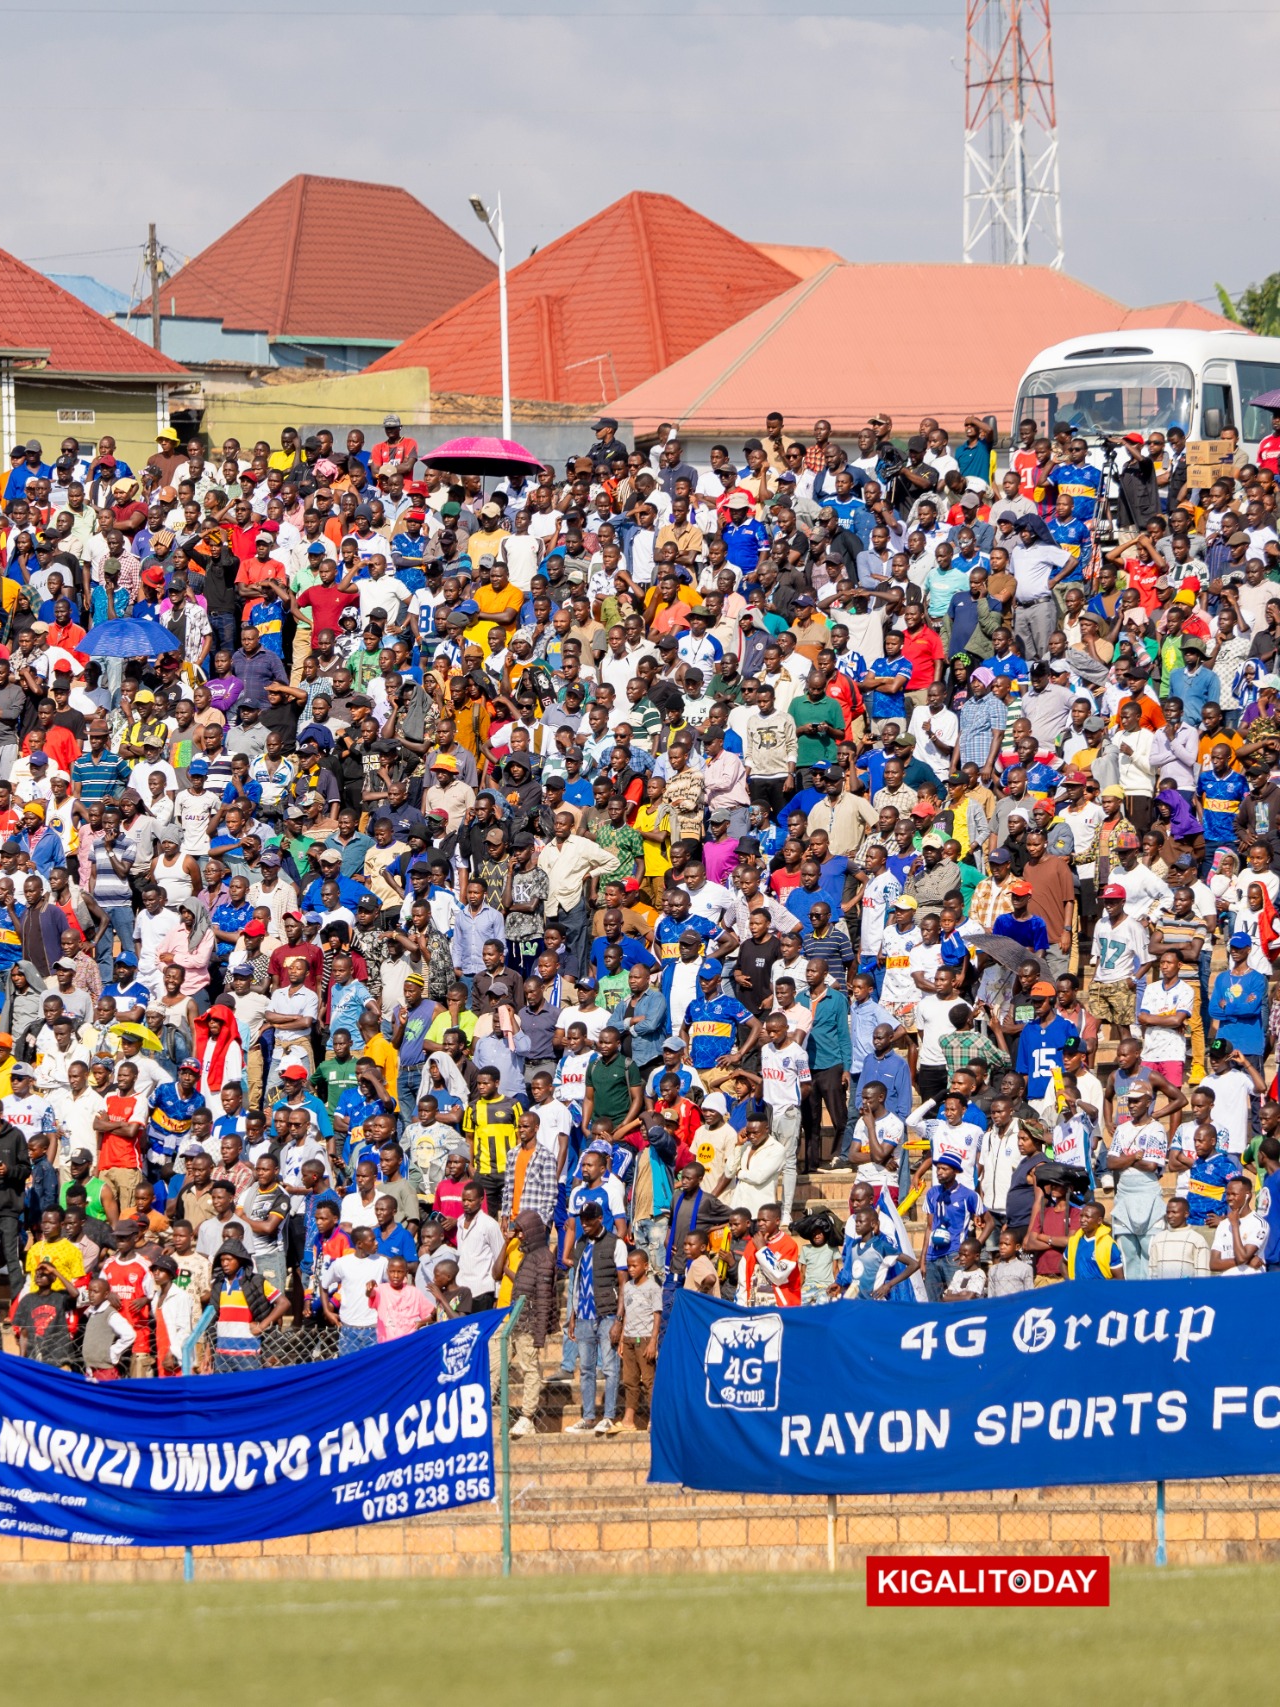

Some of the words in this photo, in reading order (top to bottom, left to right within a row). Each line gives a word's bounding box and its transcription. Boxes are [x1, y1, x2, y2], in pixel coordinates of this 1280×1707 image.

[762, 1068, 788, 1083] SKOL
[1032, 1047, 1057, 1079] 15
[562, 1073, 584, 1085] KOL
[5, 1114, 34, 1126] KOL
[901, 1316, 988, 1360] 4G
[1012, 1305, 1216, 1363] Group
[723, 1356, 763, 1386] 4G
[720, 1385, 766, 1407] Group
[780, 1408, 950, 1457] RAYON
[973, 1390, 1188, 1446] SPORTS
[1212, 1386, 1280, 1430] FC
[149, 1434, 312, 1493] UMUCYO
[319, 1412, 389, 1477] FAN
[394, 1382, 488, 1456] CLUB
[331, 1481, 373, 1505] TEL:
[374, 1450, 489, 1493] 07815591222
[362, 1491, 409, 1521] 0783
[415, 1484, 450, 1510] 238
[455, 1477, 490, 1501] 856
[18, 1520, 69, 1538] WORSHIP
